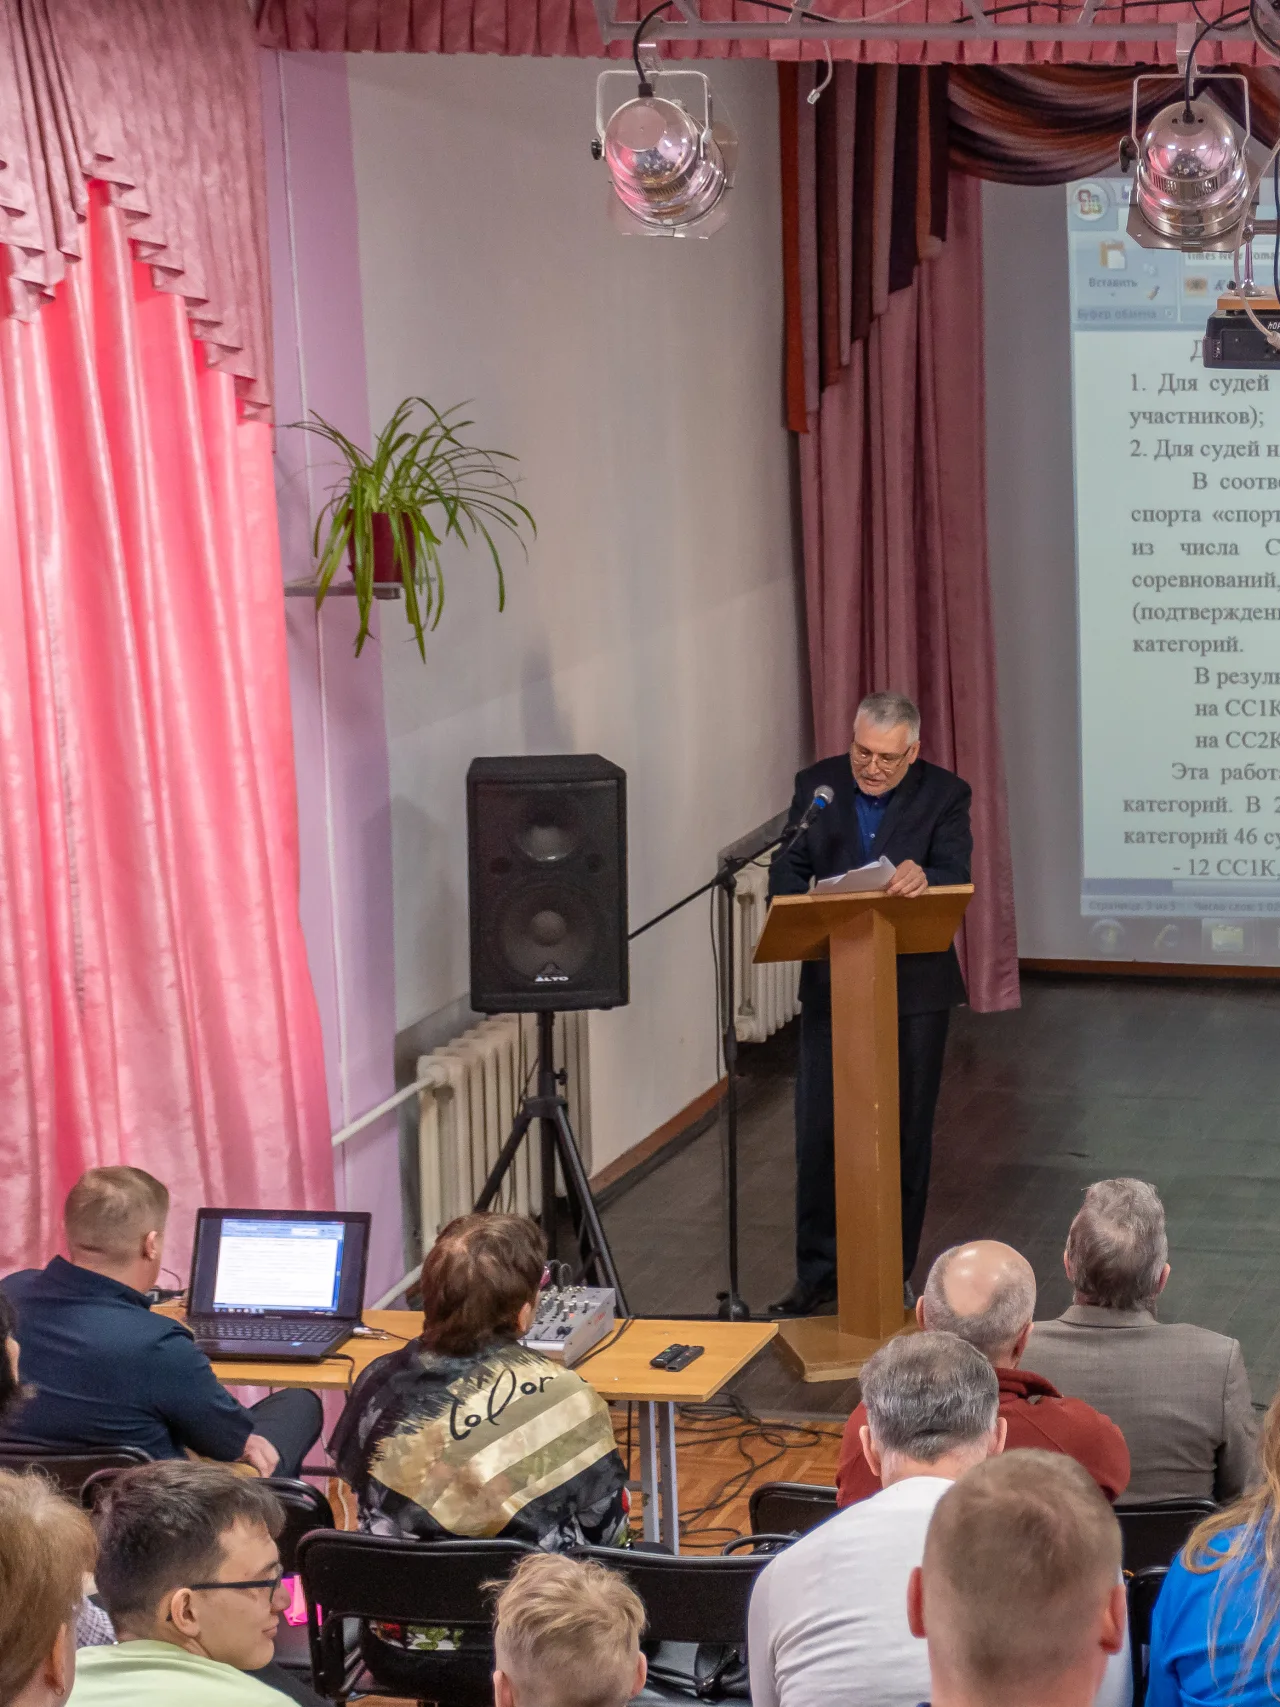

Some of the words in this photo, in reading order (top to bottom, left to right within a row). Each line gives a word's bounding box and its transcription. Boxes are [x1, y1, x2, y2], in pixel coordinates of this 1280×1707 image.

[1088, 277, 1138, 288] Вставить
[1131, 372, 1146, 391] 1.
[1158, 372, 1198, 396] Для
[1209, 373, 1269, 396] судей
[1129, 404, 1263, 429] участников);
[1130, 438, 1147, 457] 2.
[1154, 438, 1194, 461] Для
[1200, 439, 1260, 462] судей
[1193, 471, 1208, 490] В
[1131, 509, 1201, 527] спорта
[1132, 542, 1154, 556] из
[1180, 542, 1239, 556] числа
[1133, 635, 1243, 657] категорий.
[1194, 666, 1210, 684] В
[1195, 703, 1218, 716] на
[1196, 735, 1219, 748] на
[1172, 761, 1209, 780] Эта
[1124, 796, 1232, 818] категорий.
[1246, 795, 1261, 813] В
[1124, 827, 1228, 849] категорий
[1234, 827, 1257, 845] 46
[1189, 858, 1209, 875] 12
